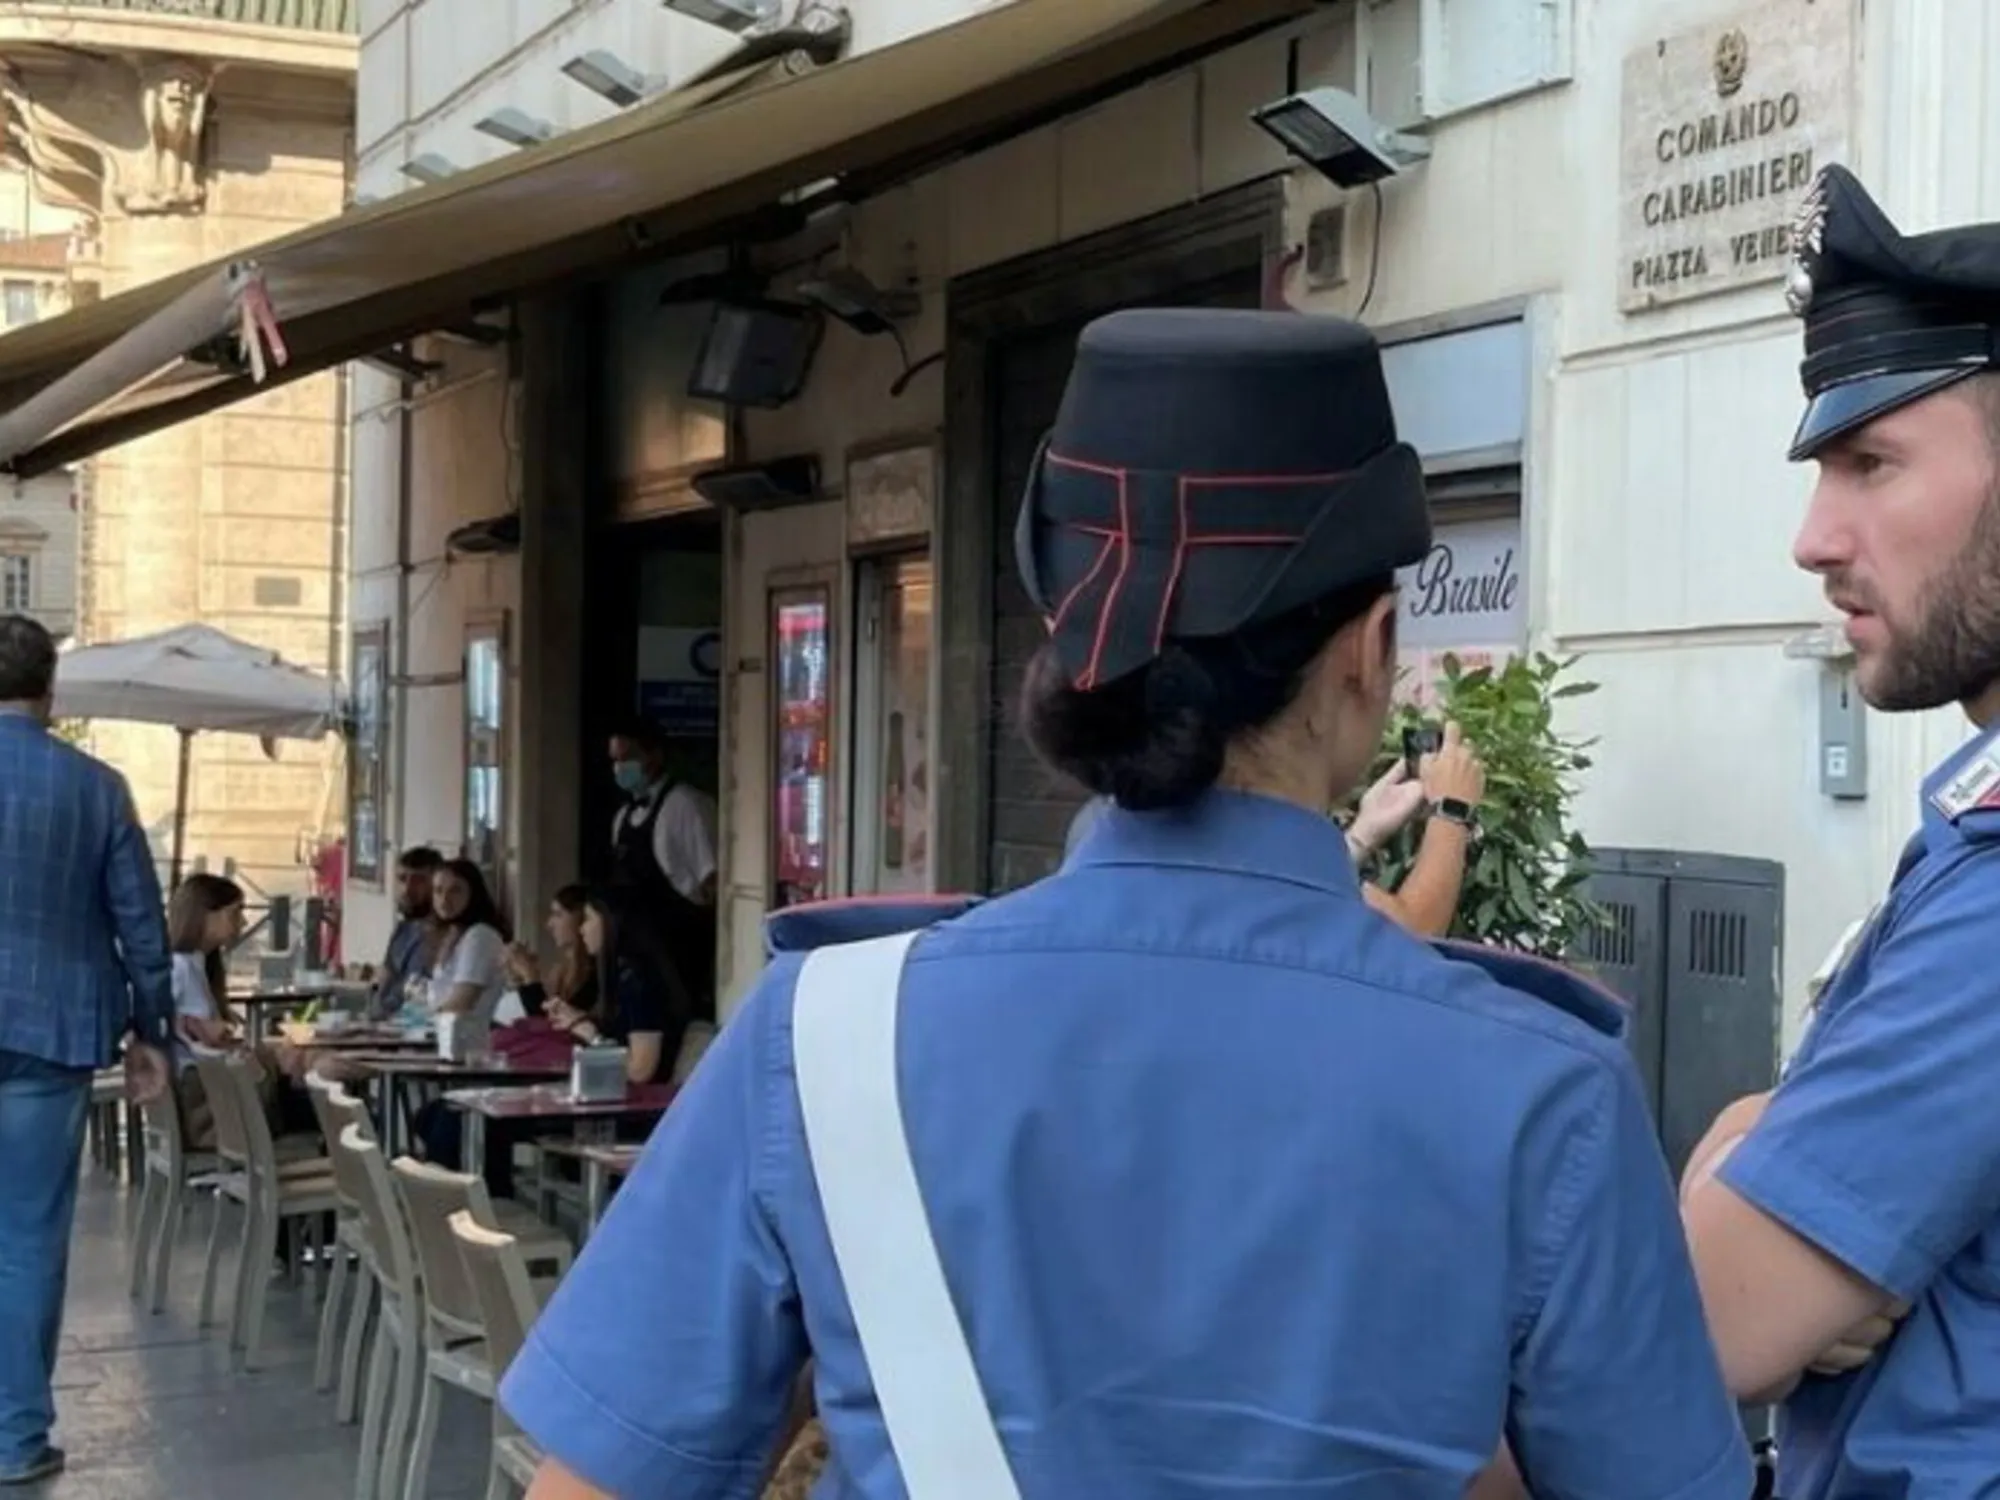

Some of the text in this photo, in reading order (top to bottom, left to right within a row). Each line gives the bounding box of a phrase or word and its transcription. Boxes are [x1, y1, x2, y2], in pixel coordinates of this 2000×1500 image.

[1655, 92, 1799, 163] COMANDO
[1642, 148, 1813, 227] CARABINIERI
[1631, 223, 1797, 289] PIAZZA VENE
